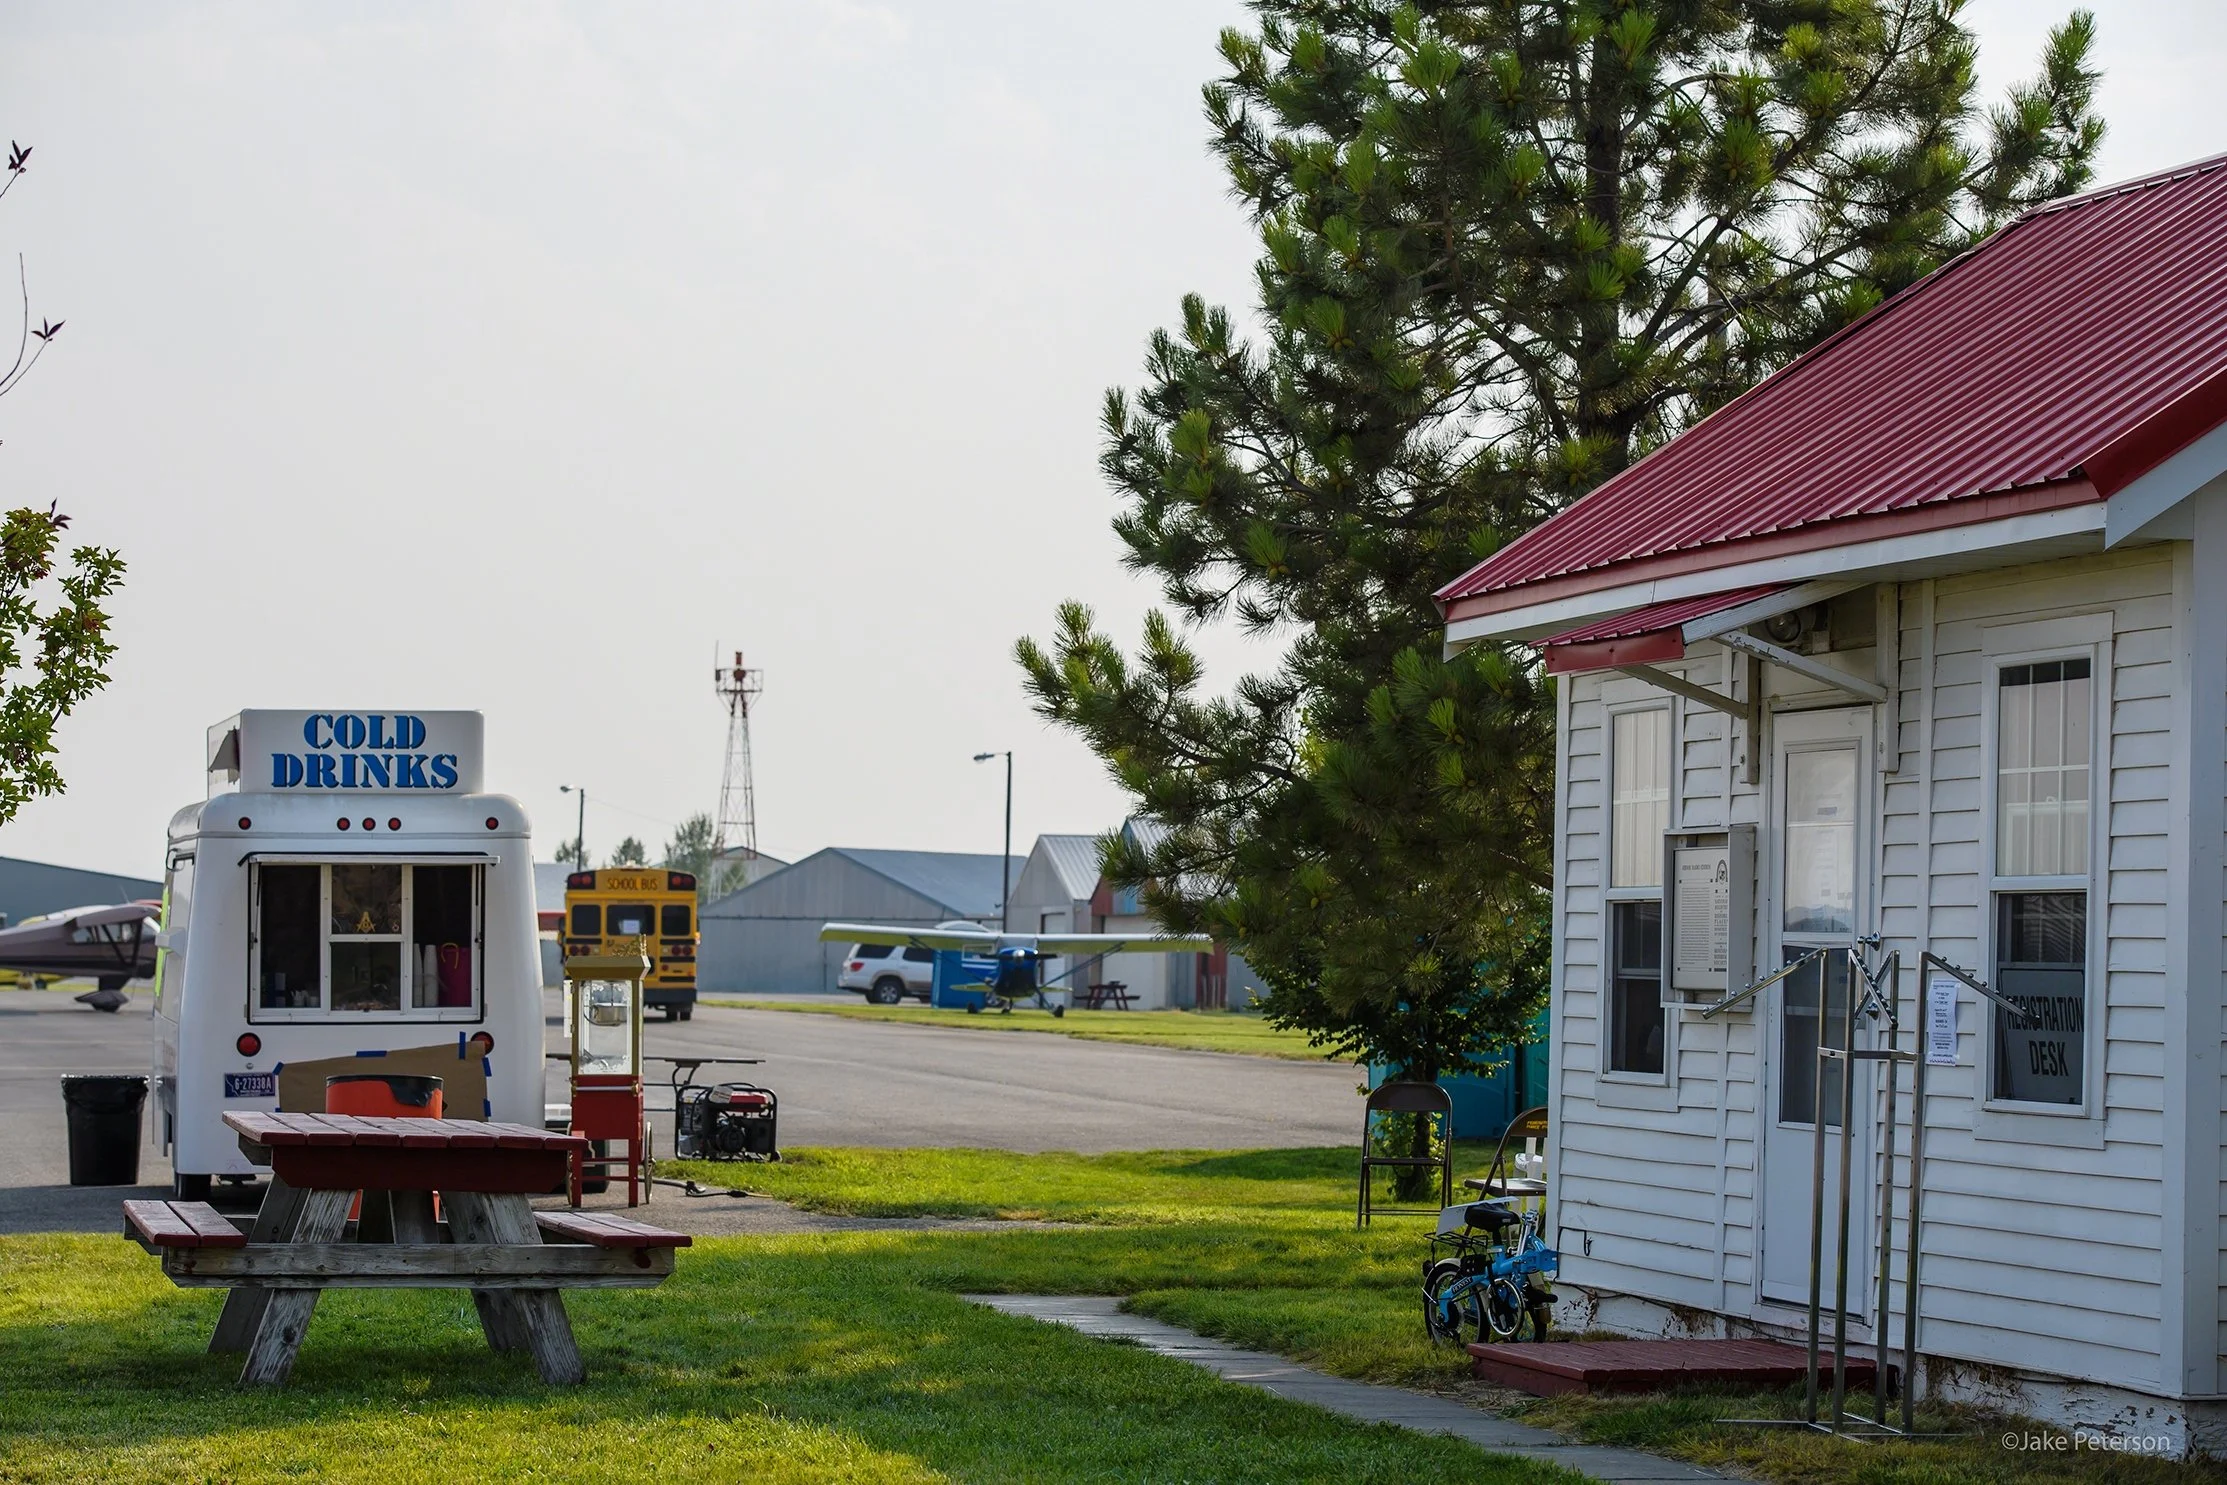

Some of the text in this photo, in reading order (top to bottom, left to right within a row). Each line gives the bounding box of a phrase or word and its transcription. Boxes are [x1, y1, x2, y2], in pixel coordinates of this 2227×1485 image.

[304, 714, 427, 750] COLD
[271, 753, 459, 788] DRINKS
[608, 877, 657, 890] SCHOOL BUS
[2029, 1040, 2069, 1077] DESK
